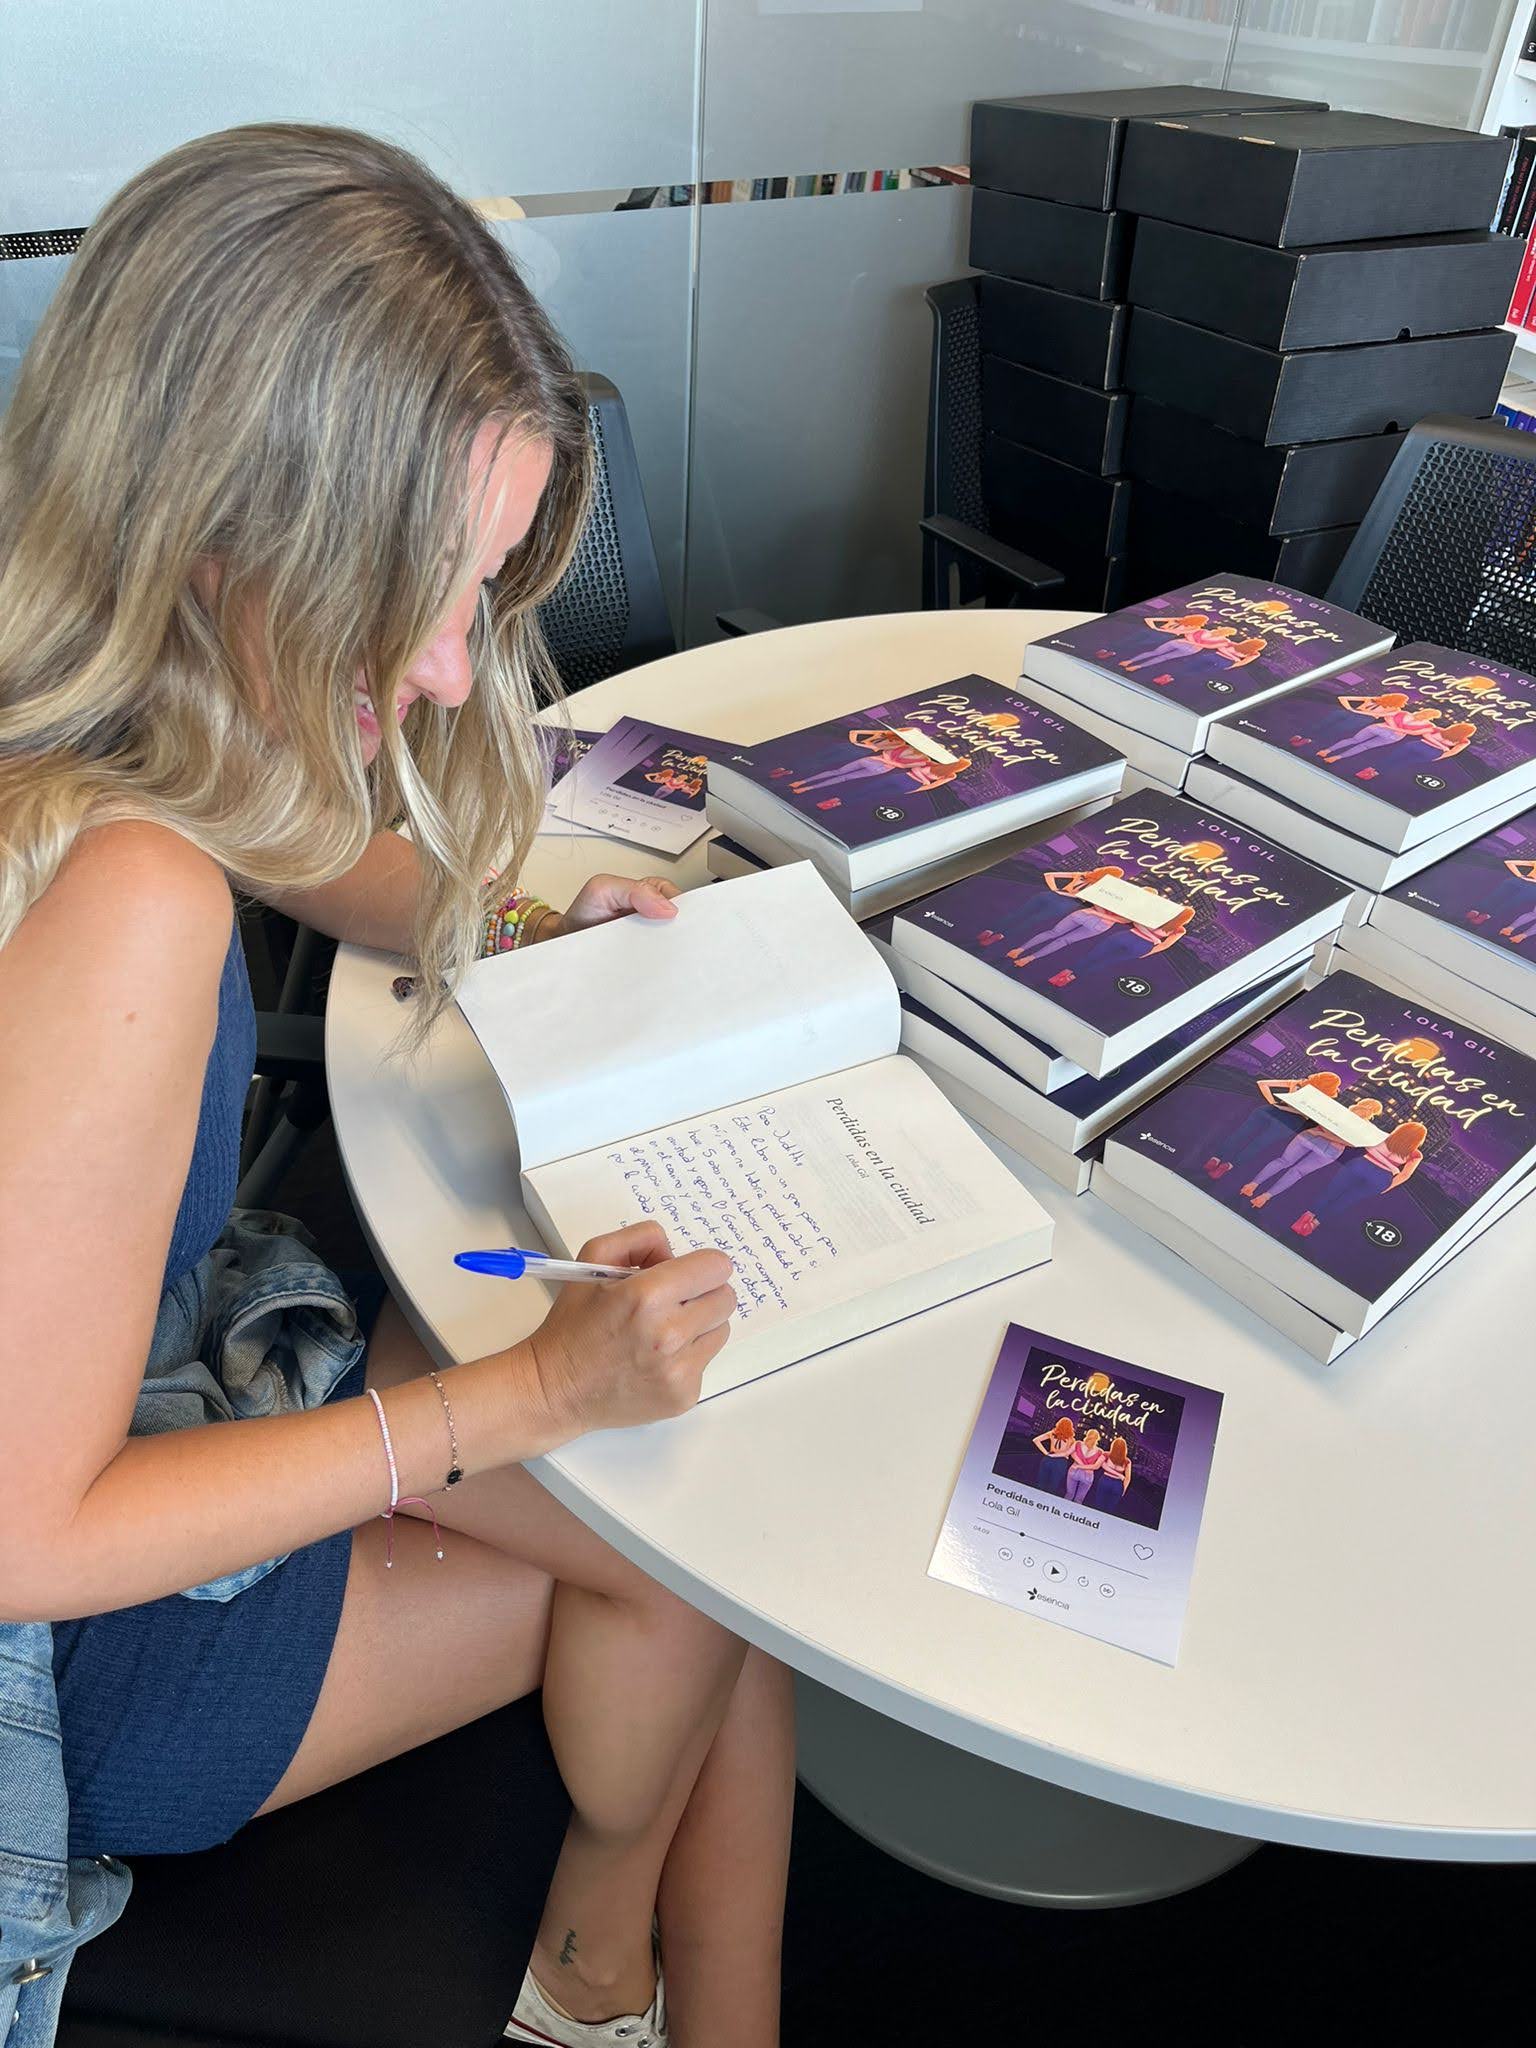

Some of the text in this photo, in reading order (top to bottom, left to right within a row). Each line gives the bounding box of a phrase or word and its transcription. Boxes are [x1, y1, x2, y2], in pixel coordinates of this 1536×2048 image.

[1186, 600, 1319, 645] la ciudad
[1192, 587, 1343, 643] Perdidas en
[1267, 587, 1332, 615] LOLA GIL
[1386, 660, 1536, 718] Perdidas e
[1469, 660, 1536, 690] LOLA GI
[1005, 697, 1067, 733] LOLA GIL
[1381, 675, 1534, 731] la ciudad
[904, 709, 1036, 767] la ciudad
[918, 694, 1062, 765] Perdidas en
[1417, 774, 1442, 788] +18
[879, 806, 899, 820] +18
[1105, 818, 1290, 906] Perdidas en
[1197, 819, 1276, 863] LOLA GIL
[1096, 840, 1260, 914] la ciudad
[1120, 976, 1146, 994] +18
[1403, 1010, 1497, 1061] LOLA GIL
[1305, 1038, 1347, 1063] la
[1351, 1056, 1493, 1130] ciudad
[1309, 1009, 1525, 1117] Perdidas en
[702, 1149, 717, 1157] 5
[826, 1097, 936, 1225] Perdidas en la ciudad
[1366, 1220, 1396, 1243] +18
[1040, 1364, 1165, 1414] Perdidas en
[1046, 1390, 1150, 1433] la ciudad
[982, 1497, 1021, 1517] Lola Gil
[986, 1483, 1100, 1530] Perdidas en la ciudad
[1037, 1592, 1070, 1610] esencia
